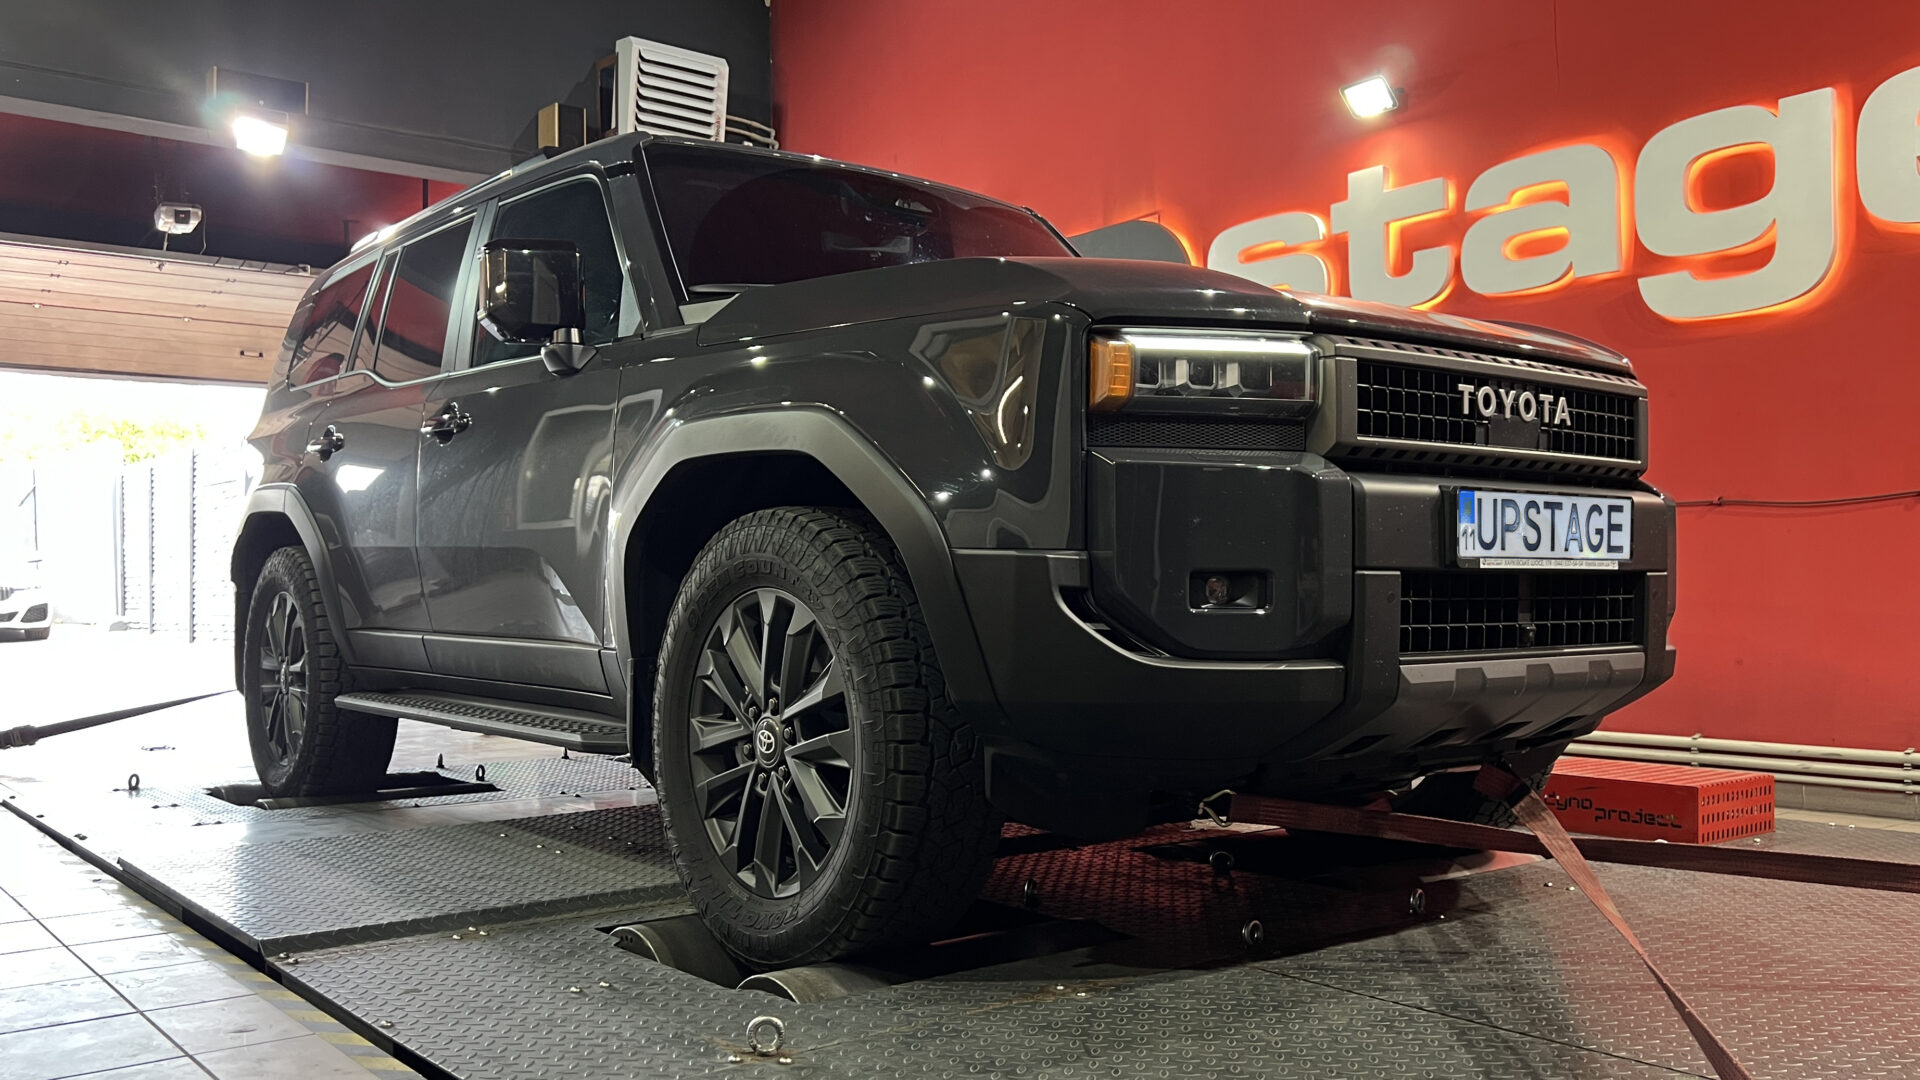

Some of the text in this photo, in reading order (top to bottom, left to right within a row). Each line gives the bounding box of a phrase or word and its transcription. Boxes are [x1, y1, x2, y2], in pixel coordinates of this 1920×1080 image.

[1458, 383, 1571, 426] TOYOTA
[1462, 525, 1475, 550] 11
[1477, 498, 1624, 553] UPSTAGE
[1544, 792, 1592, 811] dyno
[1595, 807, 1682, 829] project
